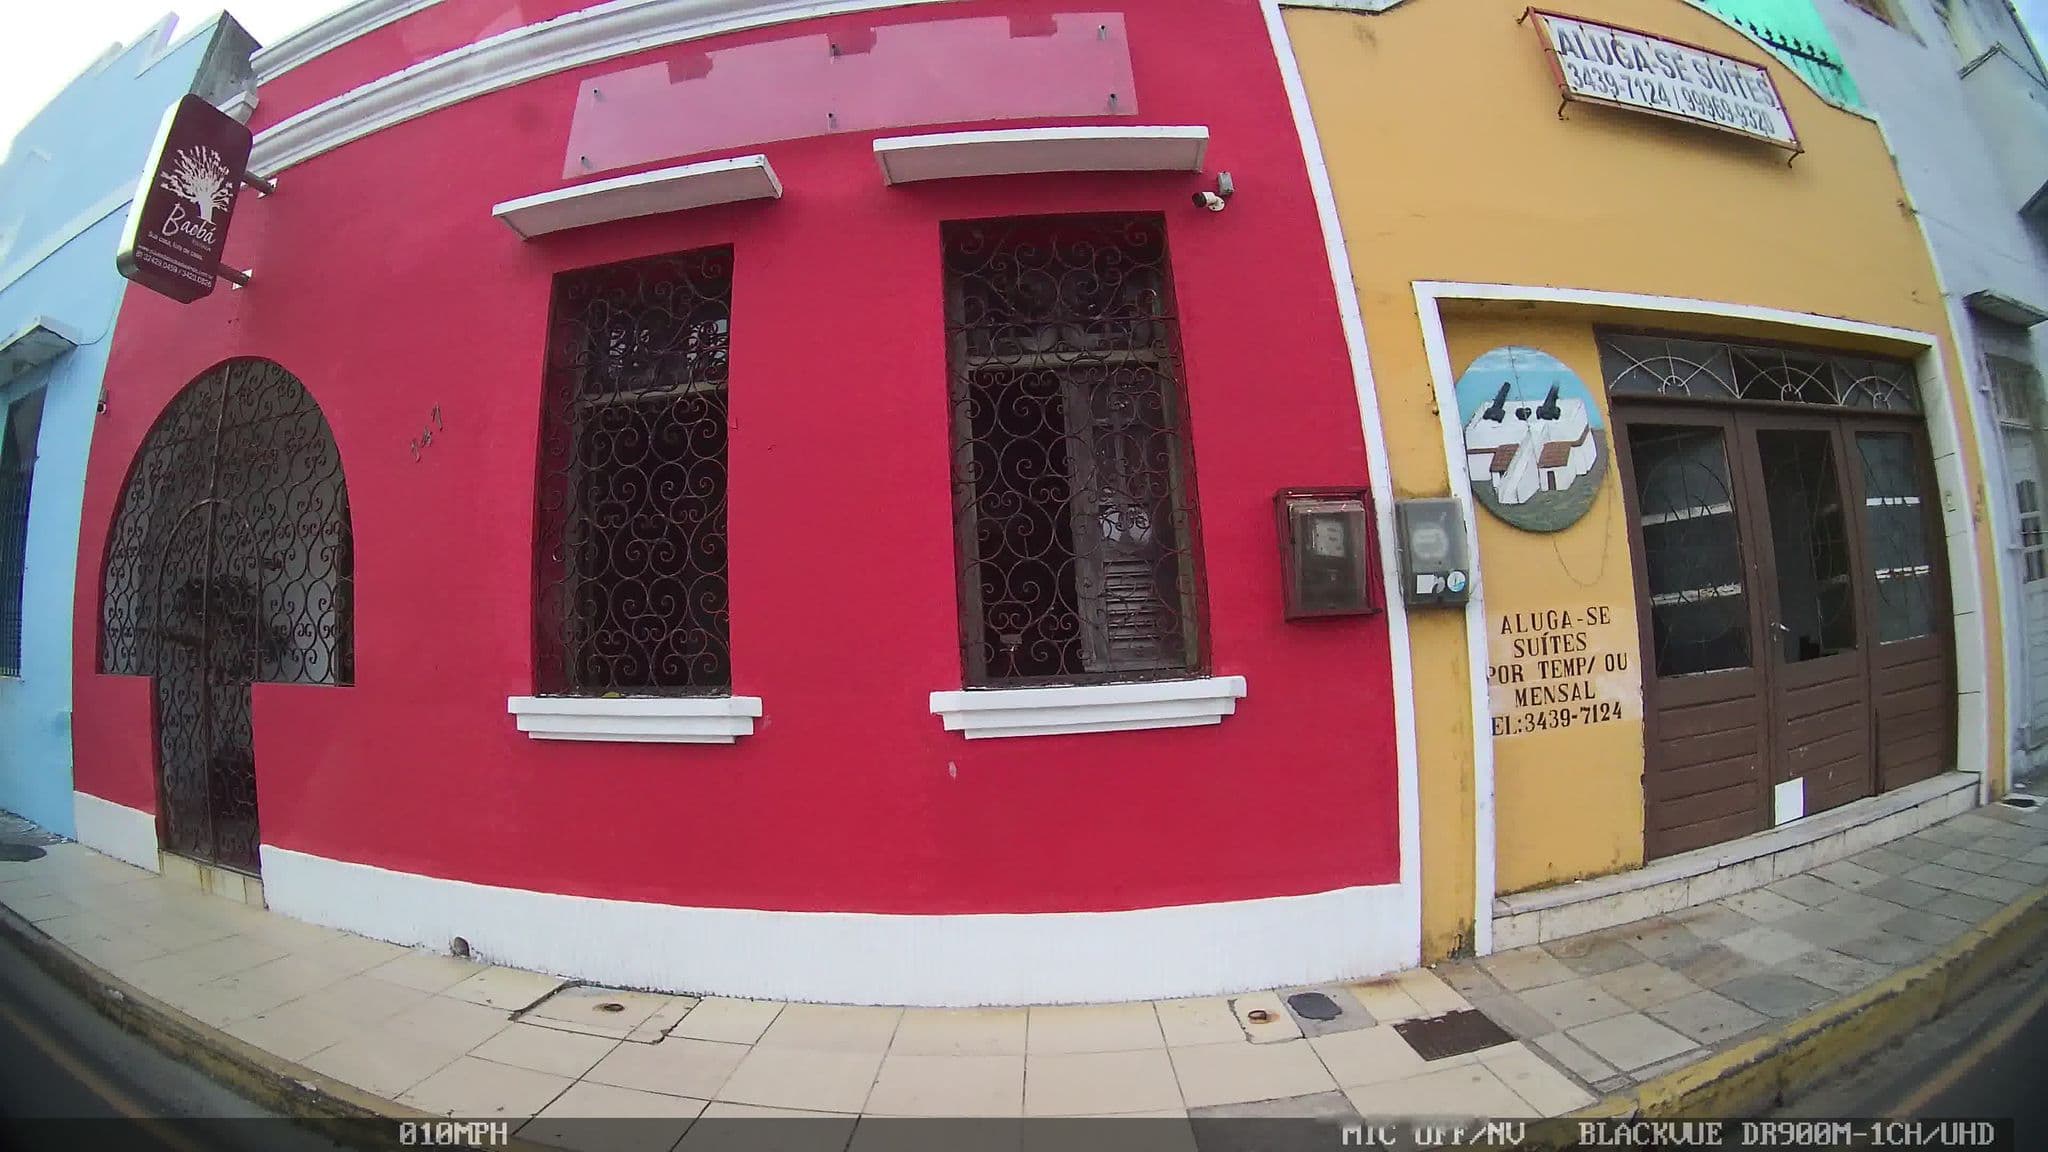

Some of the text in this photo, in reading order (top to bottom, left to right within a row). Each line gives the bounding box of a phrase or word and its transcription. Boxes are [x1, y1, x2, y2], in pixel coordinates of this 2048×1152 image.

[1557, 28, 1693, 84] ALUGA-SE
[1567, 62, 1671, 107] 3439-7124
[162, 203, 216, 244] Baobá
[1501, 606, 1611, 635] ALUGA-SE
[1513, 632, 1588, 658] SUÍTES
[1538, 656, 1596, 680] TEMP/
[1605, 652, 1628, 672] OU
[1515, 681, 1596, 708] MENSAL
